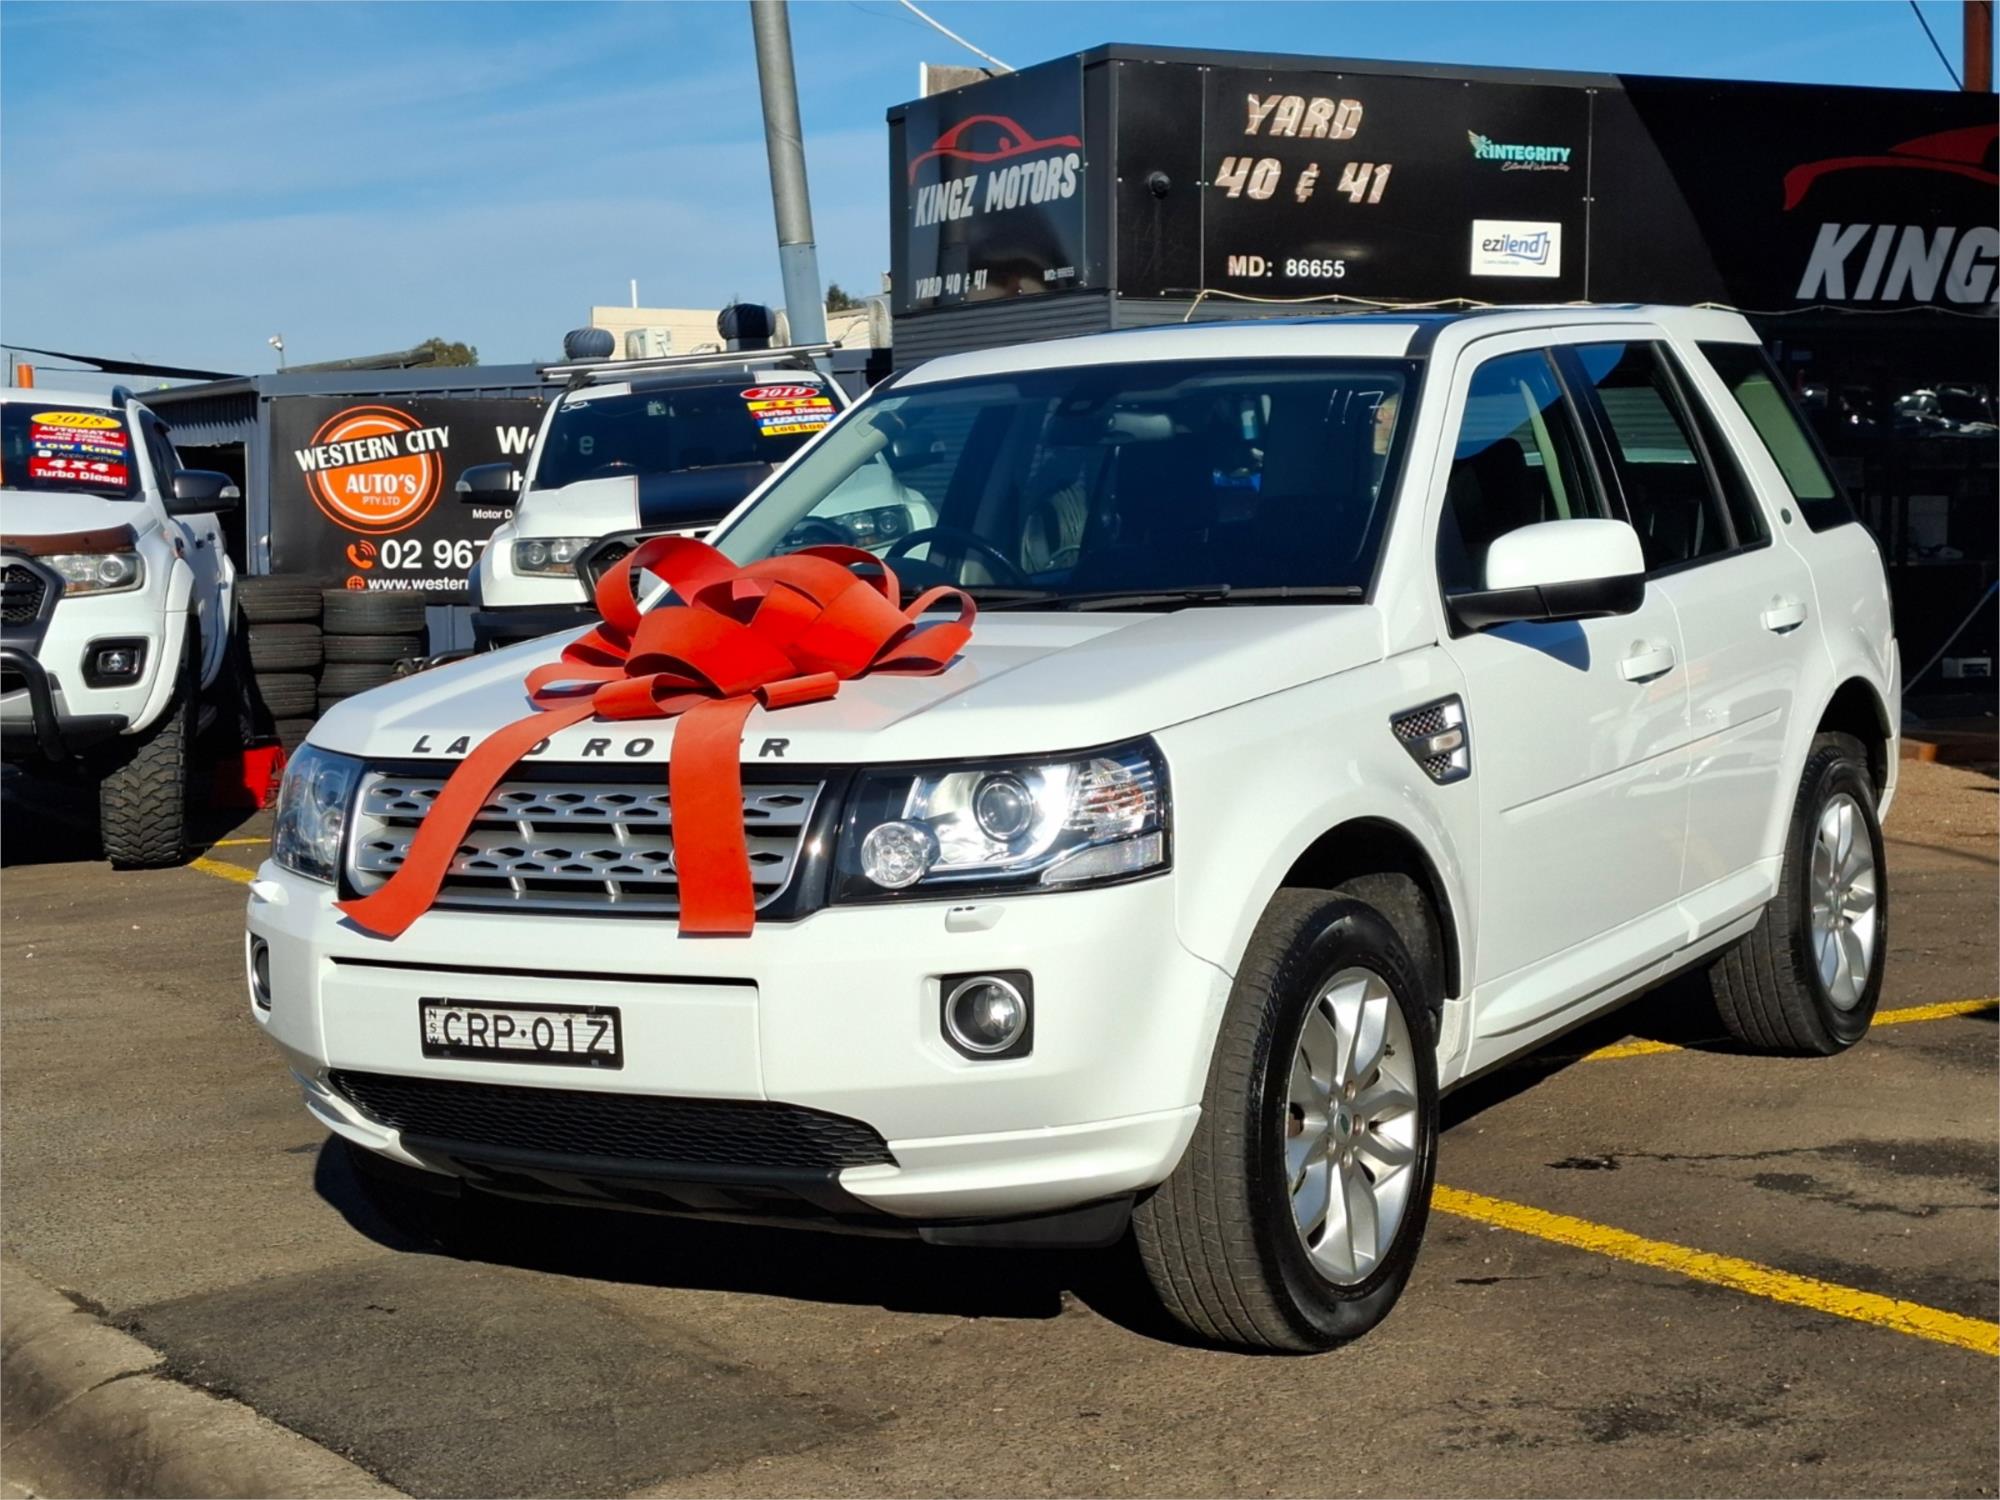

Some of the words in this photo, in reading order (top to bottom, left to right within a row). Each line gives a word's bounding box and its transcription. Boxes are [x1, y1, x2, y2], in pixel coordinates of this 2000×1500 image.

[1244, 93, 1364, 140] YARD
[1489, 144, 1571, 162] INTEGRITY
[1214, 156, 1282, 199] 40
[1337, 162, 1392, 203] 41
[915, 175, 978, 228] KINGZ
[984, 153, 1080, 214] MOTORS
[1482, 233, 1540, 253] ezilend
[1228, 255, 1272, 277] MD:
[1285, 259, 1345, 278] 86655
[1795, 222, 2000, 303] KING
[915, 276, 942, 299] YARD
[945, 273, 961, 295] 40
[974, 269, 988, 290] 41
[759, 387, 807, 398] 2019
[48, 415, 105, 425] 2018
[758, 409, 792, 418] Turbo
[795, 406, 832, 416] Diesel
[763, 414, 834, 426] LUXURY
[40, 426, 119, 438] AUTOMATIC
[772, 425, 796, 433] Log
[35, 441, 75, 450] Low
[81, 444, 123, 456] Kms
[294, 435, 399, 472] WESTERN
[405, 426, 449, 453] CITY
[35, 468, 76, 479] Turbo
[80, 471, 123, 484] Diesel
[346, 473, 417, 494] AUTO'S
[472, 509, 503, 519] Motor
[381, 539, 422, 570] 02
[411, 735, 551, 755] LAD
[582, 737, 790, 757] ROR
